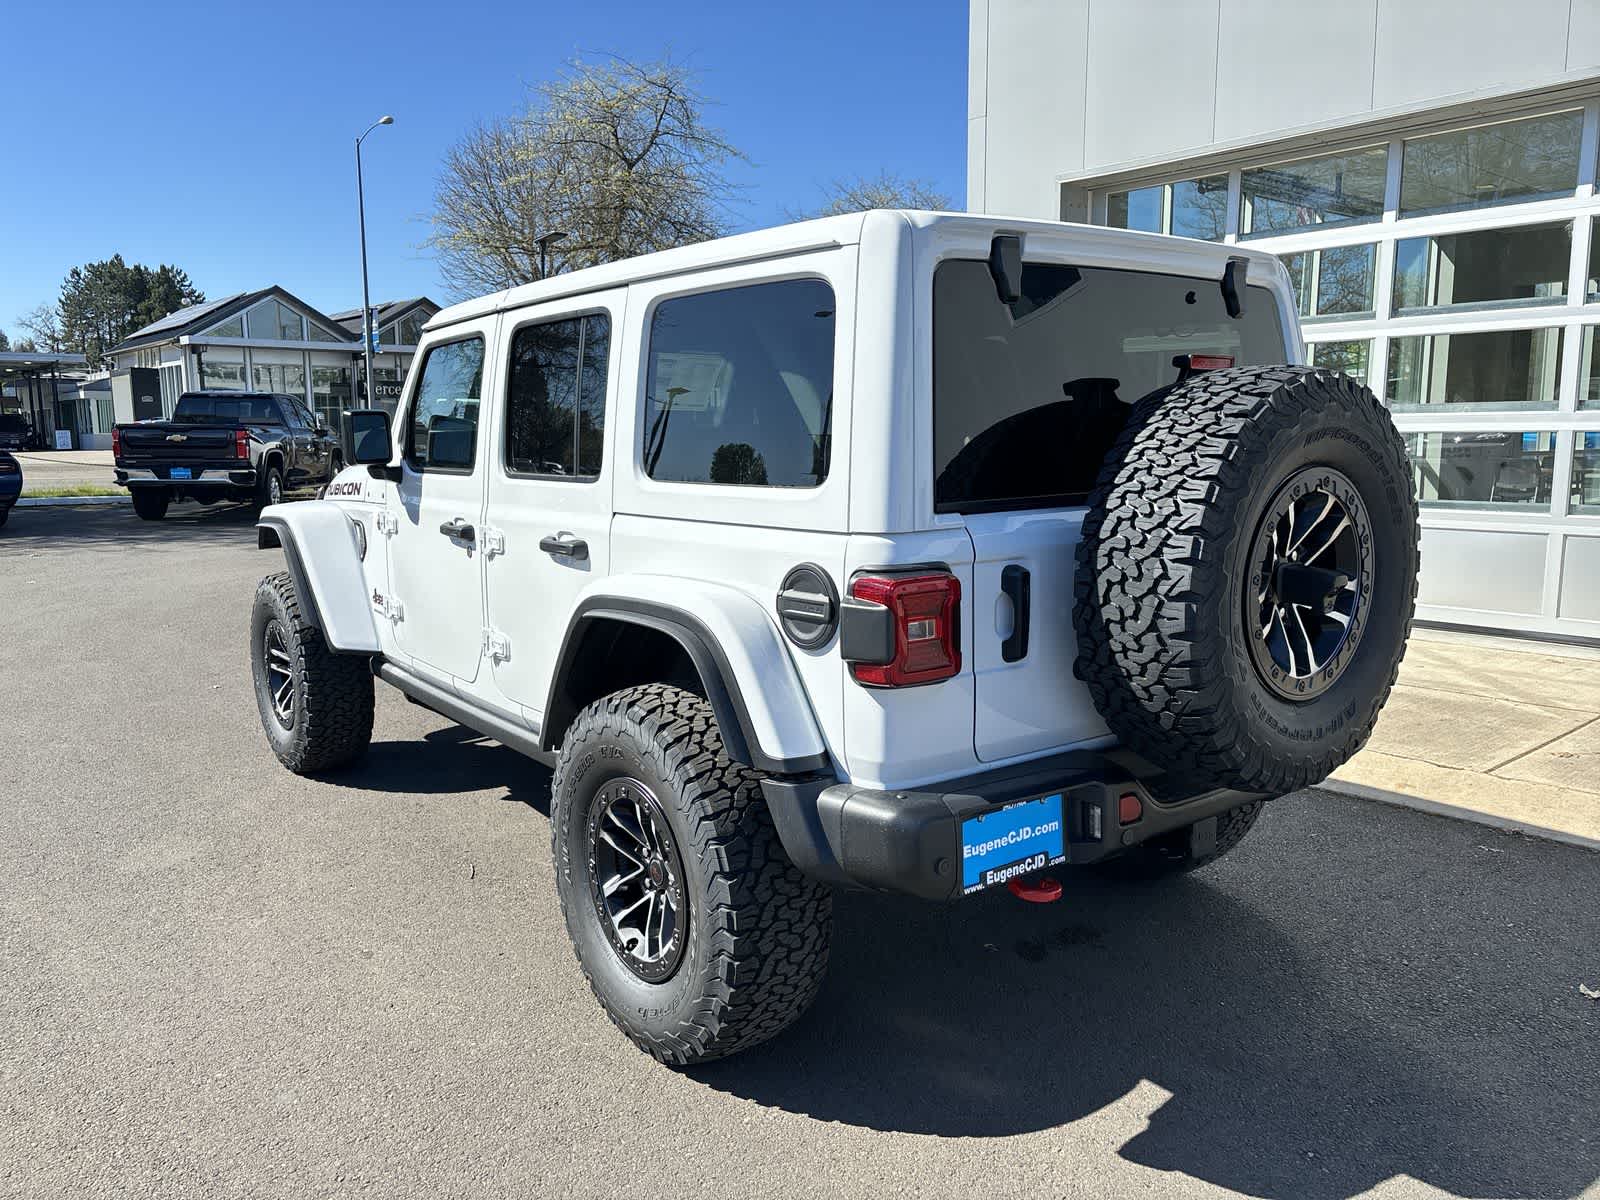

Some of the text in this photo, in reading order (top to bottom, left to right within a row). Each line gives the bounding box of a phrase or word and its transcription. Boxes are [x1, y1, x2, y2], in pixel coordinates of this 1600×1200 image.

[963, 820, 1059, 858] EugeneCJD.com
[964, 854, 1066, 895] www. EugeneCJD .com
